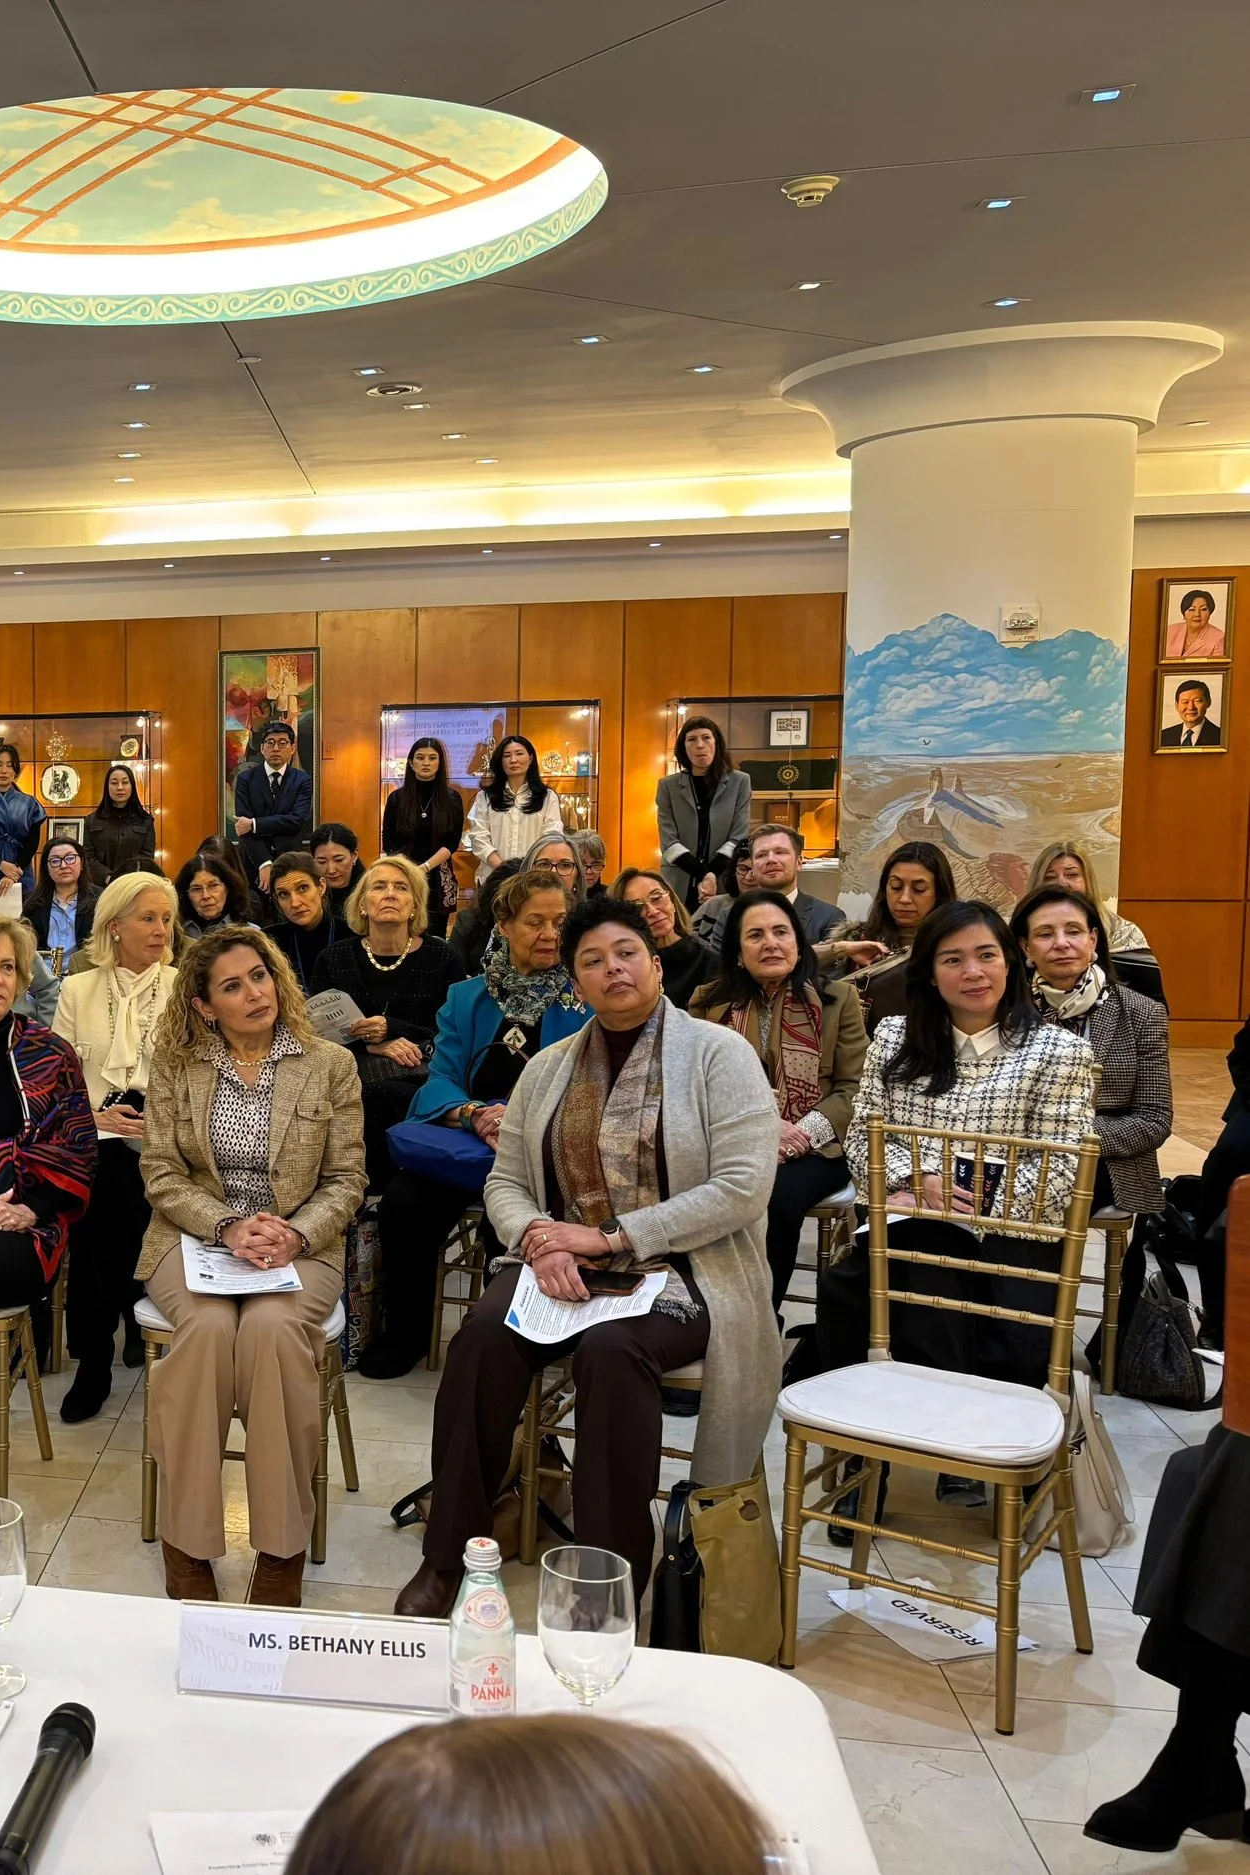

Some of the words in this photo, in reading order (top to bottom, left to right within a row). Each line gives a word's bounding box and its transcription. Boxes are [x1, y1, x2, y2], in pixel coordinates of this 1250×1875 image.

[890, 1599, 984, 1646] RESERVED
[249, 1632, 282, 1650] MS.
[288, 1635, 375, 1655] BETHANY
[380, 1640, 426, 1658] ELLIS
[482, 1677, 504, 1685] ACQUA
[471, 1684, 511, 1701] PANNA
